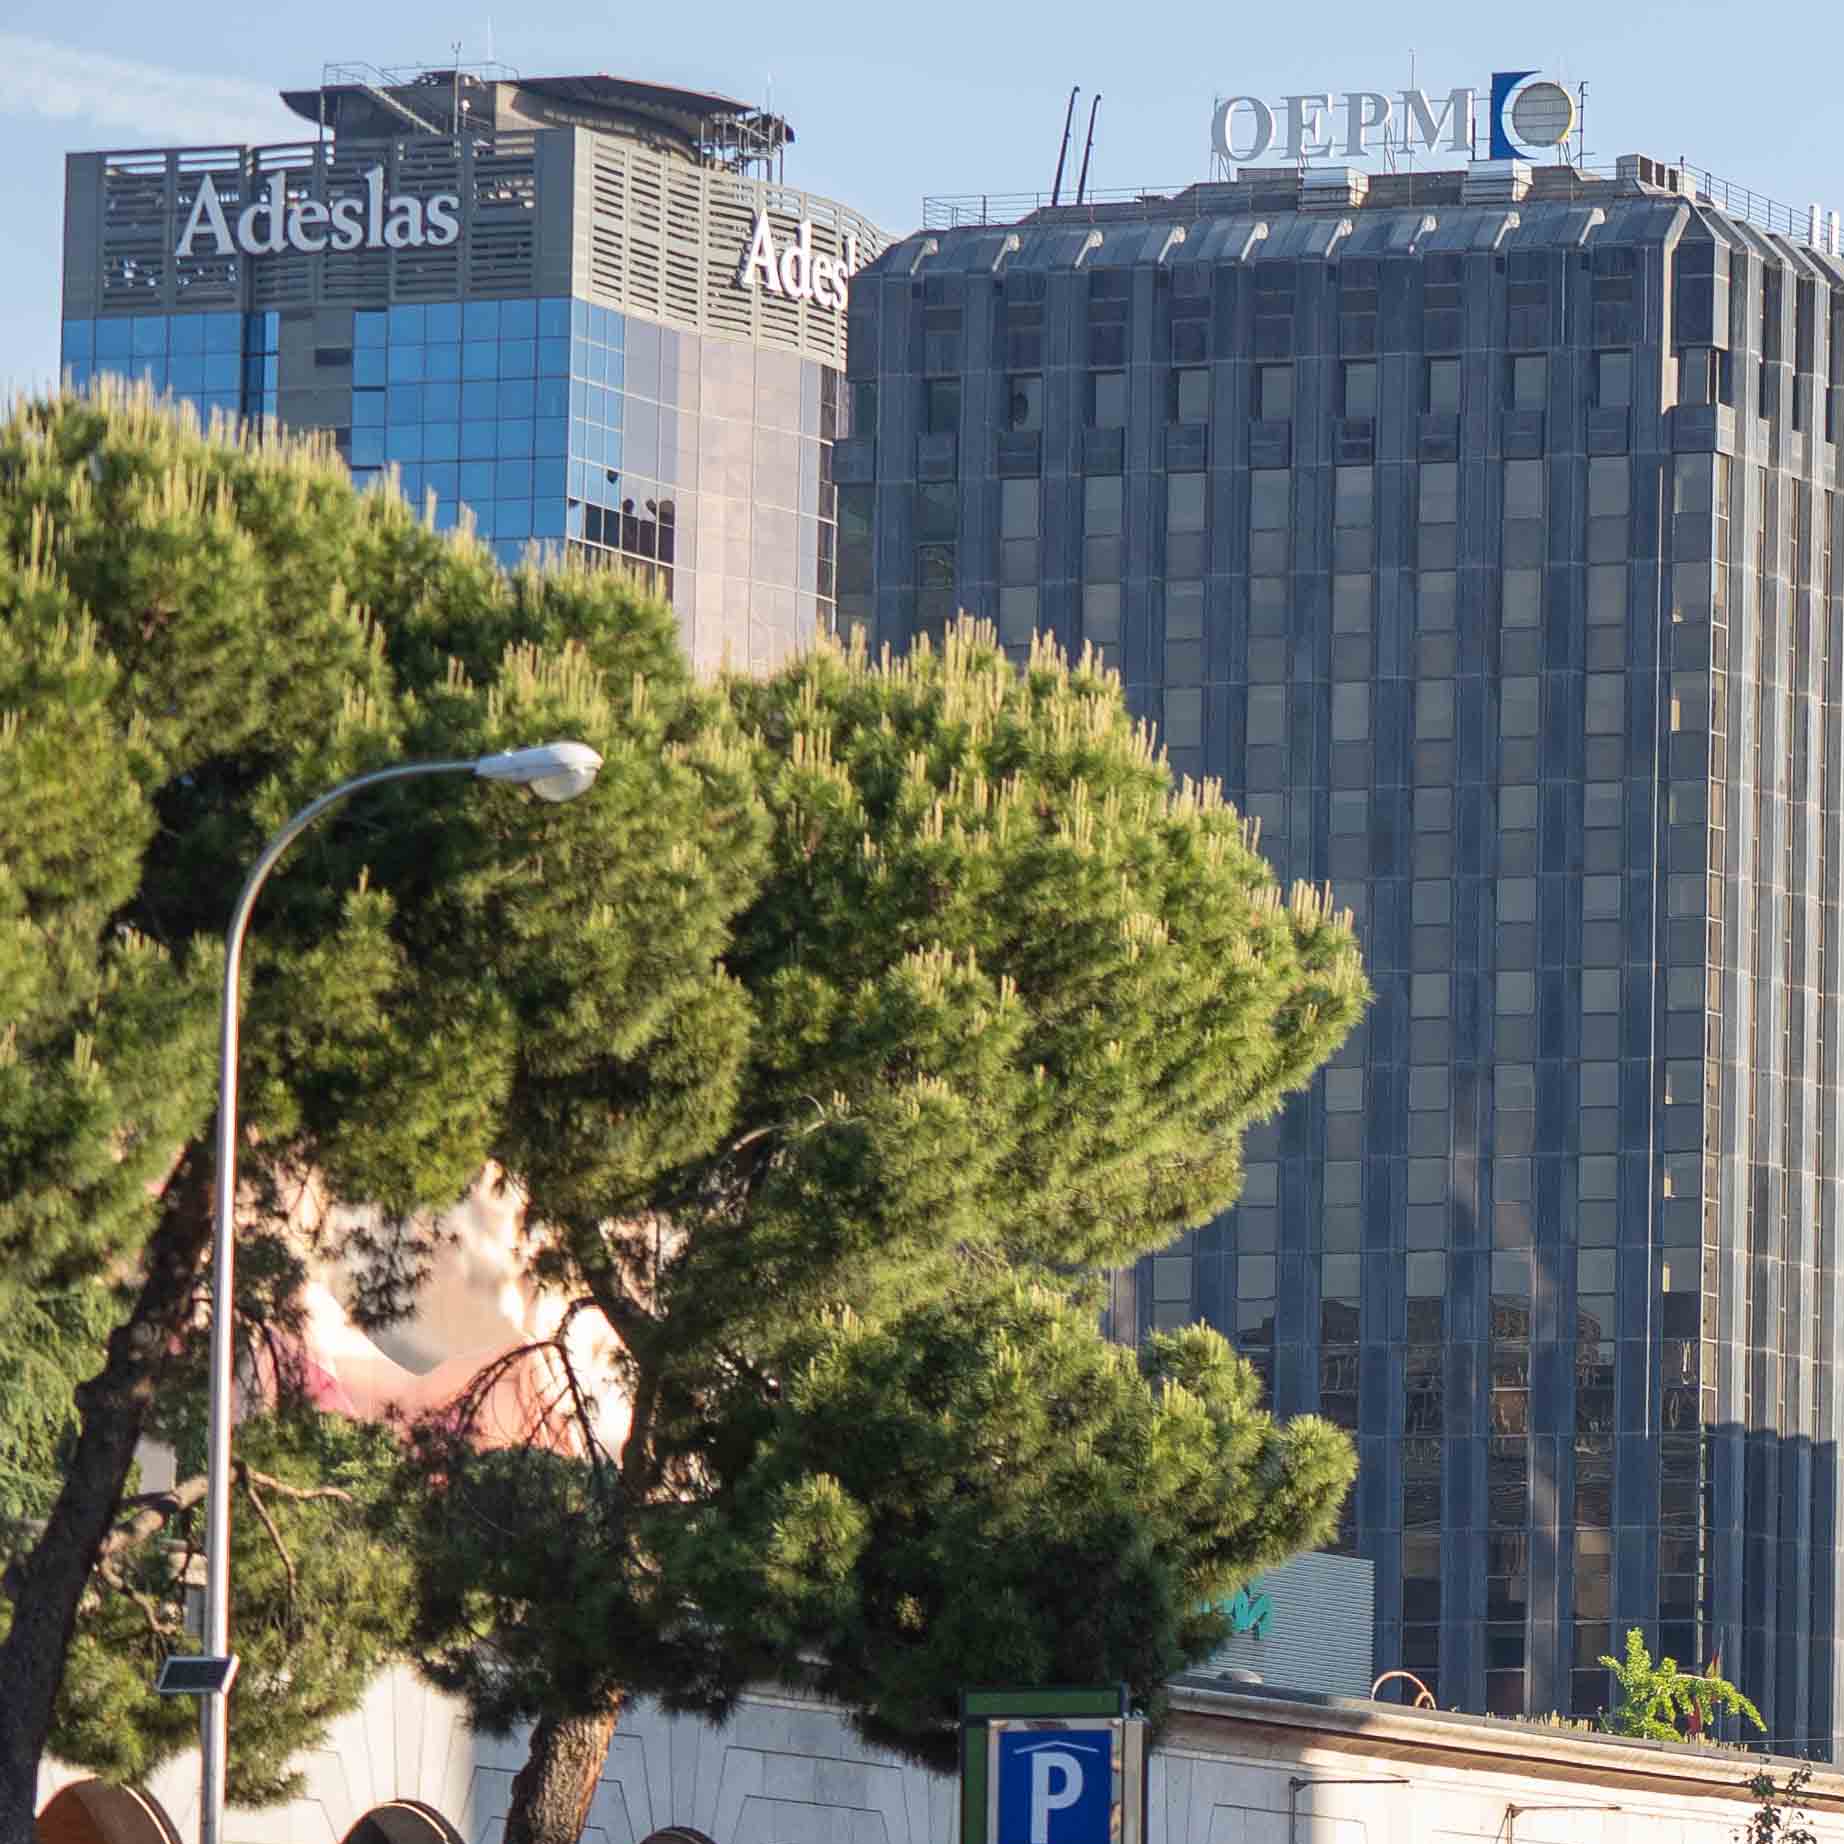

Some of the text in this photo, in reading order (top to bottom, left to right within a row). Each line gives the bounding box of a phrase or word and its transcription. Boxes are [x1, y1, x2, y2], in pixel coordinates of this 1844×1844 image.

[1211, 87, 1477, 161] OEPM
[174, 164, 461, 256] Adeslas
[1030, 1752, 1083, 1844] P
